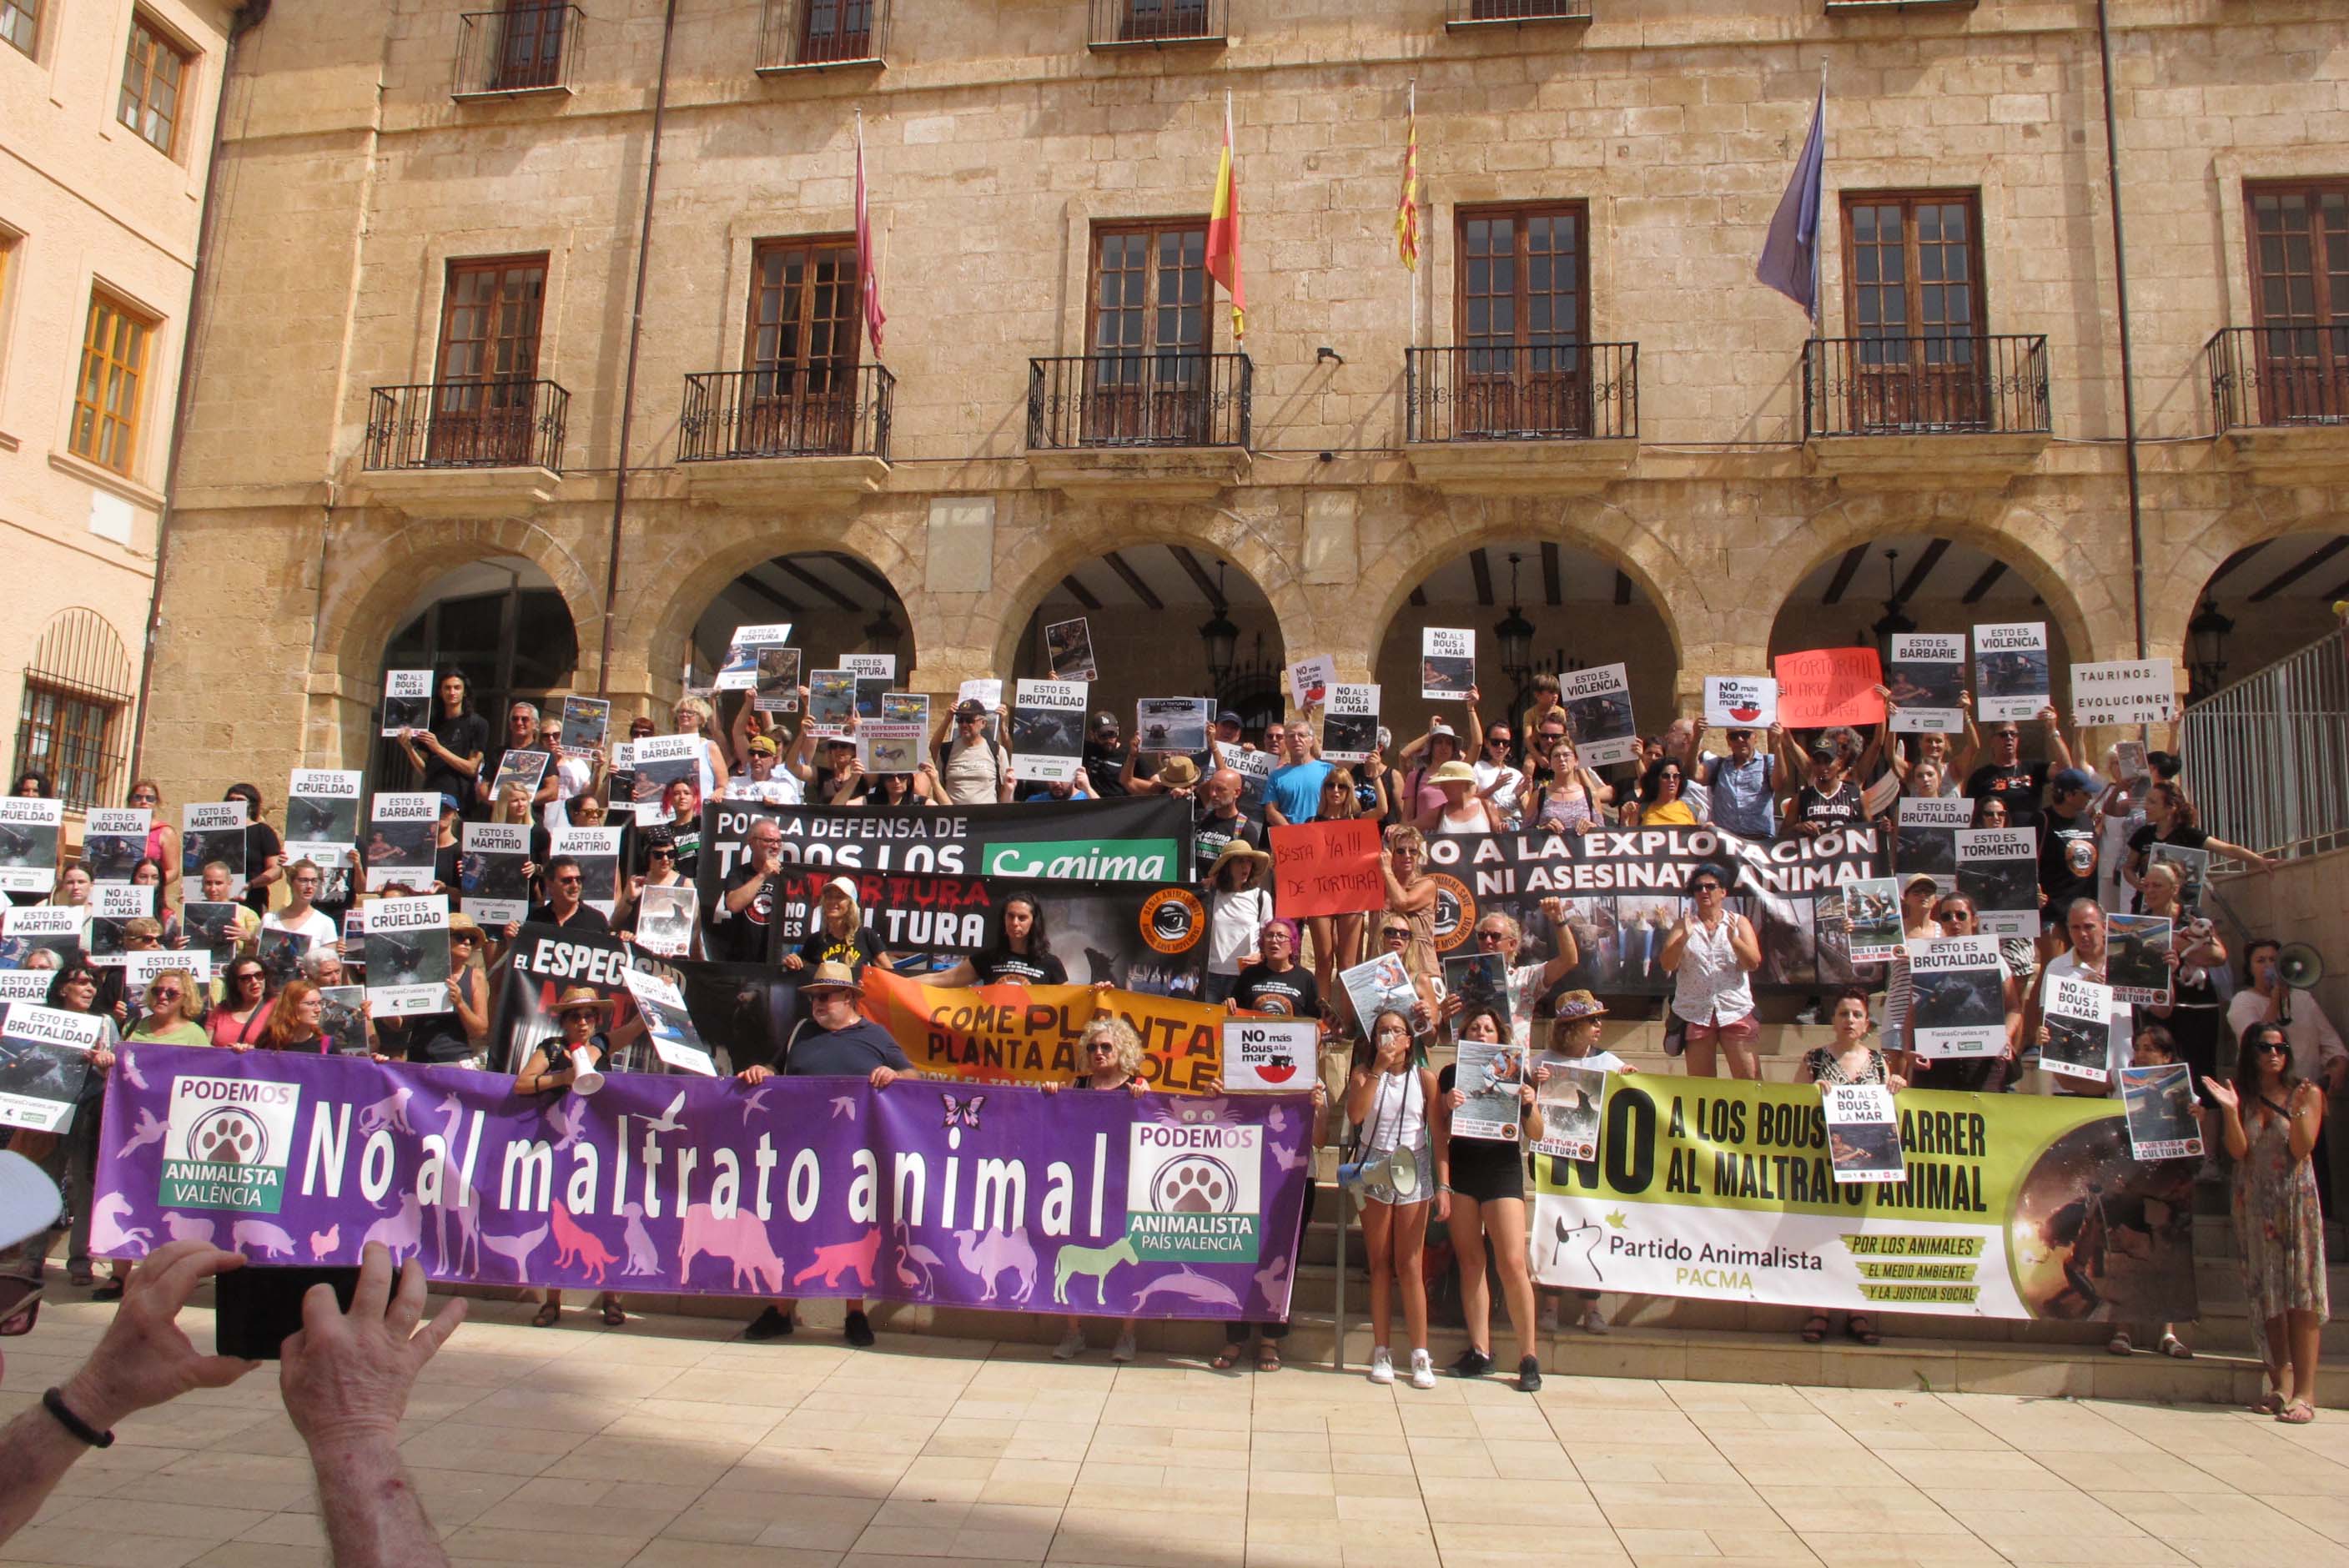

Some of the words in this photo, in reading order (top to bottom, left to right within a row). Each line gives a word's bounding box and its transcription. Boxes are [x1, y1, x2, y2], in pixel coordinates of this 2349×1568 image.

[1991, 629, 2011, 637] ESTO
[2015, 628, 2029, 636] ES
[1909, 640, 1932, 648] ESTO
[1936, 640, 1948, 648] ES
[1982, 637, 2040, 648] VIOLENCIA
[1899, 648, 1957, 659] BARBARIE
[1575, 673, 1596, 683] ESTO
[1599, 671, 1610, 681] ES
[1034, 685, 1056, 694] ESTO
[1059, 686, 1070, 695] ES
[1336, 687, 1350, 696] NO
[1567, 679, 1622, 697] VIOLENCIA
[1718, 682, 1738, 691] NO
[1019, 694, 1084, 706] BRUTALIDAD
[1335, 696, 1361, 704] BOUS
[2079, 694, 2170, 708] EVOLUCIONEN
[1346, 705, 1368, 713] MAR
[2090, 714, 2115, 724] POR
[650, 740, 669, 749] ESTO
[673, 738, 683, 747] ES
[641, 746, 692, 759] BARBARIE
[1229, 750, 1250, 760] ESTO
[1252, 755, 1262, 763] ES
[307, 774, 329, 782] ESTO
[332, 773, 345, 782] ES
[295, 782, 354, 795] CRUELDAD
[390, 797, 408, 807] ESTO
[411, 797, 424, 807] ES
[1917, 802, 1940, 812] ESTO
[1944, 802, 1956, 812] ES
[102, 812, 122, 822] ESTO
[124, 812, 135, 822] ES
[198, 807, 219, 817] ESTO
[221, 807, 231, 816] ES
[380, 807, 432, 818] BARBARIE
[1808, 805, 1850, 817] CHICAGO
[191, 816, 239, 827] MARTIRIO
[1902, 812, 1971, 823] BRUTALIDAD
[92, 821, 143, 832] VIOLENCIA
[479, 828, 499, 837] ESTO
[503, 828, 514, 837] ES
[812, 817, 927, 838] DEFENSA
[935, 817, 968, 837] DE
[568, 831, 588, 841] ESTO
[591, 832, 605, 841] ES
[1974, 834, 1997, 843] ESTO
[2004, 834, 2016, 843] ES
[470, 838, 521, 850] MARTIRIO
[559, 840, 611, 852] MARTIRIO
[1472, 839, 1504, 864] A
[1517, 835, 1572, 860] LA
[1962, 844, 2030, 857] TORMENTO
[1288, 881, 1305, 897] DE
[1314, 870, 1378, 893] TORTURA
[1476, 869, 1514, 896] NI
[105, 888, 120, 897] NO
[123, 889, 141, 897] ALS
[103, 897, 133, 907] BOUS
[383, 902, 410, 914] ESTO
[414, 902, 428, 913] ES
[23, 911, 48, 920] ESTO
[52, 911, 65, 920] ES
[118, 907, 141, 916] MAR
[785, 902, 807, 918] NO
[13, 919, 73, 931] MARTIRIO
[372, 912, 441, 928] CRUELDAD
[783, 921, 803, 937] ES
[1930, 942, 1960, 953] ESTO
[1964, 941, 1979, 952] ES
[147, 957, 174, 966] ESTO
[178, 957, 191, 966] ES
[514, 953, 528, 970] EL
[1914, 952, 1997, 968] BRUTALIDAD
[2, 977, 30, 985] ESTO
[33, 977, 48, 985] ES
[2060, 981, 2076, 994] NO
[2080, 986, 2100, 998] ALS
[2058, 993, 2090, 1008] BOUS
[2057, 1003, 2070, 1015] LA
[2072, 1007, 2099, 1020] MAR
[30, 1012, 58, 1025] ESTO
[63, 1018, 78, 1028] ES
[929, 1006, 1015, 1033] COME
[7, 1020, 93, 1044] BRUTALIDAD
[1241, 1029, 1265, 1043] NO
[928, 1033, 1044, 1069] PLANTA
[1241, 1043, 1273, 1053] Bous
[1241, 1053, 1266, 1063] mar
[180, 1080, 290, 1105] PODEMOS
[1837, 1090, 1855, 1100] NO
[1858, 1090, 1878, 1099] ALS
[1838, 1101, 1871, 1111] BOUS
[1668, 1096, 1686, 1138] A
[1698, 1098, 1746, 1144] LOS
[1757, 1102, 1826, 1149] BOUS
[1838, 1112, 1853, 1122] LA
[1854, 1111, 1883, 1121] MAR
[1139, 1127, 1254, 1149] PODEMOS
[1537, 1143, 1577, 1157] CULTURA
[2142, 1148, 2185, 1158] CULTURA
[165, 1163, 278, 1186] ANIMALISTA
[302, 1101, 396, 1202] No
[417, 1110, 485, 1208] al
[499, 1114, 820, 1223] maltrato
[848, 1127, 1108, 1238] animal
[1666, 1147, 1702, 1194] AL
[1876, 1162, 1987, 1212] ANIMAL
[174, 1183, 262, 1207] VALÈNCIA
[1130, 1215, 1254, 1235] ANIMALISTA
[1141, 1234, 1174, 1250] PAÍS
[1174, 1234, 1243, 1251] VALENCIÀ
[1853, 1236, 1877, 1253] POR
[1881, 1237, 1905, 1254] LOS
[1908, 1238, 1974, 1255] ANIMALES
[1609, 1235, 1692, 1262] Partido
[1699, 1242, 1823, 1270] Animalista
[1869, 1264, 1879, 1276] EL
[1882, 1264, 1914, 1278] MEDIO
[1917, 1265, 1967, 1279] AMBIENTE
[1675, 1267, 1753, 1290] PACMA
[1879, 1287, 1891, 1299] LA
[1893, 1287, 1937, 1299] JUSTICIA
[1940, 1289, 1974, 1301] SOCIAL
